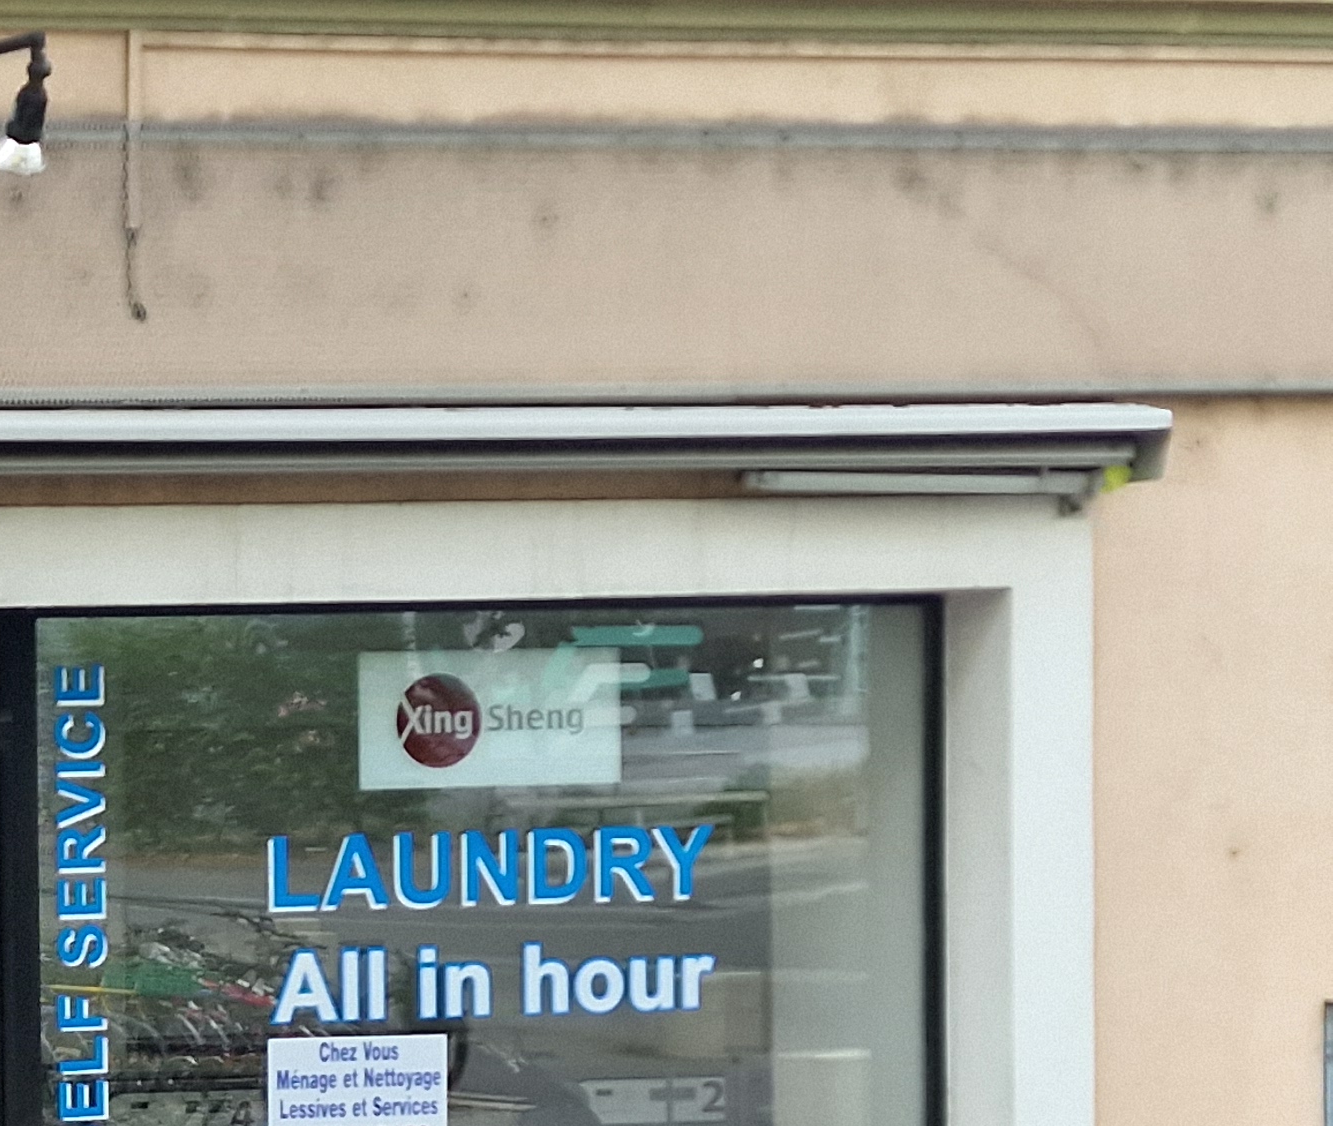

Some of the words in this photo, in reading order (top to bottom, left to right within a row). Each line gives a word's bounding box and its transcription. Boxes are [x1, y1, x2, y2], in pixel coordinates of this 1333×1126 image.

[399, 700, 473, 744] Xing
[486, 704, 583, 735] Sheng
[55, 663, 108, 968] SERVICE
[266, 823, 714, 913] LAUNDRY
[269, 945, 388, 1026] All
[416, 944, 493, 1020] in
[521, 941, 717, 1017] hour
[319, 1041, 358, 1062] Chez
[363, 1041, 399, 1061] Vous
[276, 1069, 337, 1093] Ménage
[343, 1071, 358, 1088] et
[363, 1067, 441, 1091] Nettoyage
[701, 1080, 725, 1113] 2
[279, 1098, 346, 1119] Lessives
[352, 1099, 367, 1117] et
[373, 1096, 439, 1116] Services
